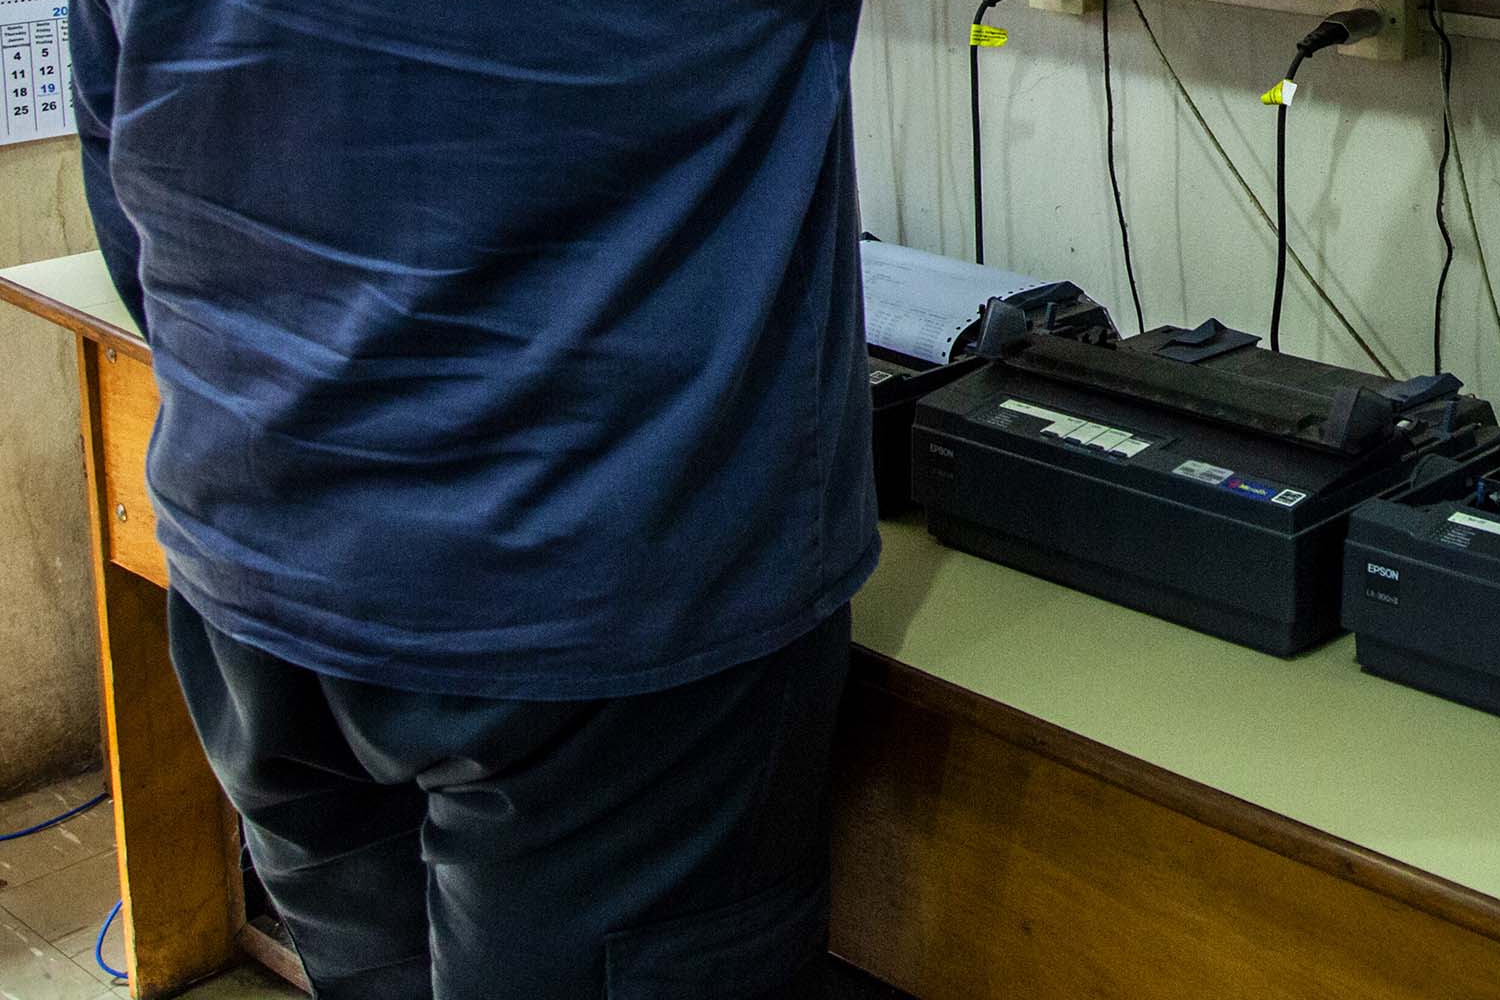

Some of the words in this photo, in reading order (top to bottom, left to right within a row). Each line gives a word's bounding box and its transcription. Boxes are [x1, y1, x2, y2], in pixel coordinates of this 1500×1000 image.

[13, 52, 21, 60] 4
[42, 48, 49, 57] 5
[11, 70, 26, 79] 11
[40, 66, 54, 75] 12
[13, 88, 28, 98] 18
[40, 83, 55, 93] 19
[14, 106, 29, 116] 25
[42, 102, 57, 112] 26
[930, 442, 954, 458] EPSON
[1368, 562, 1399, 581] EPSON
